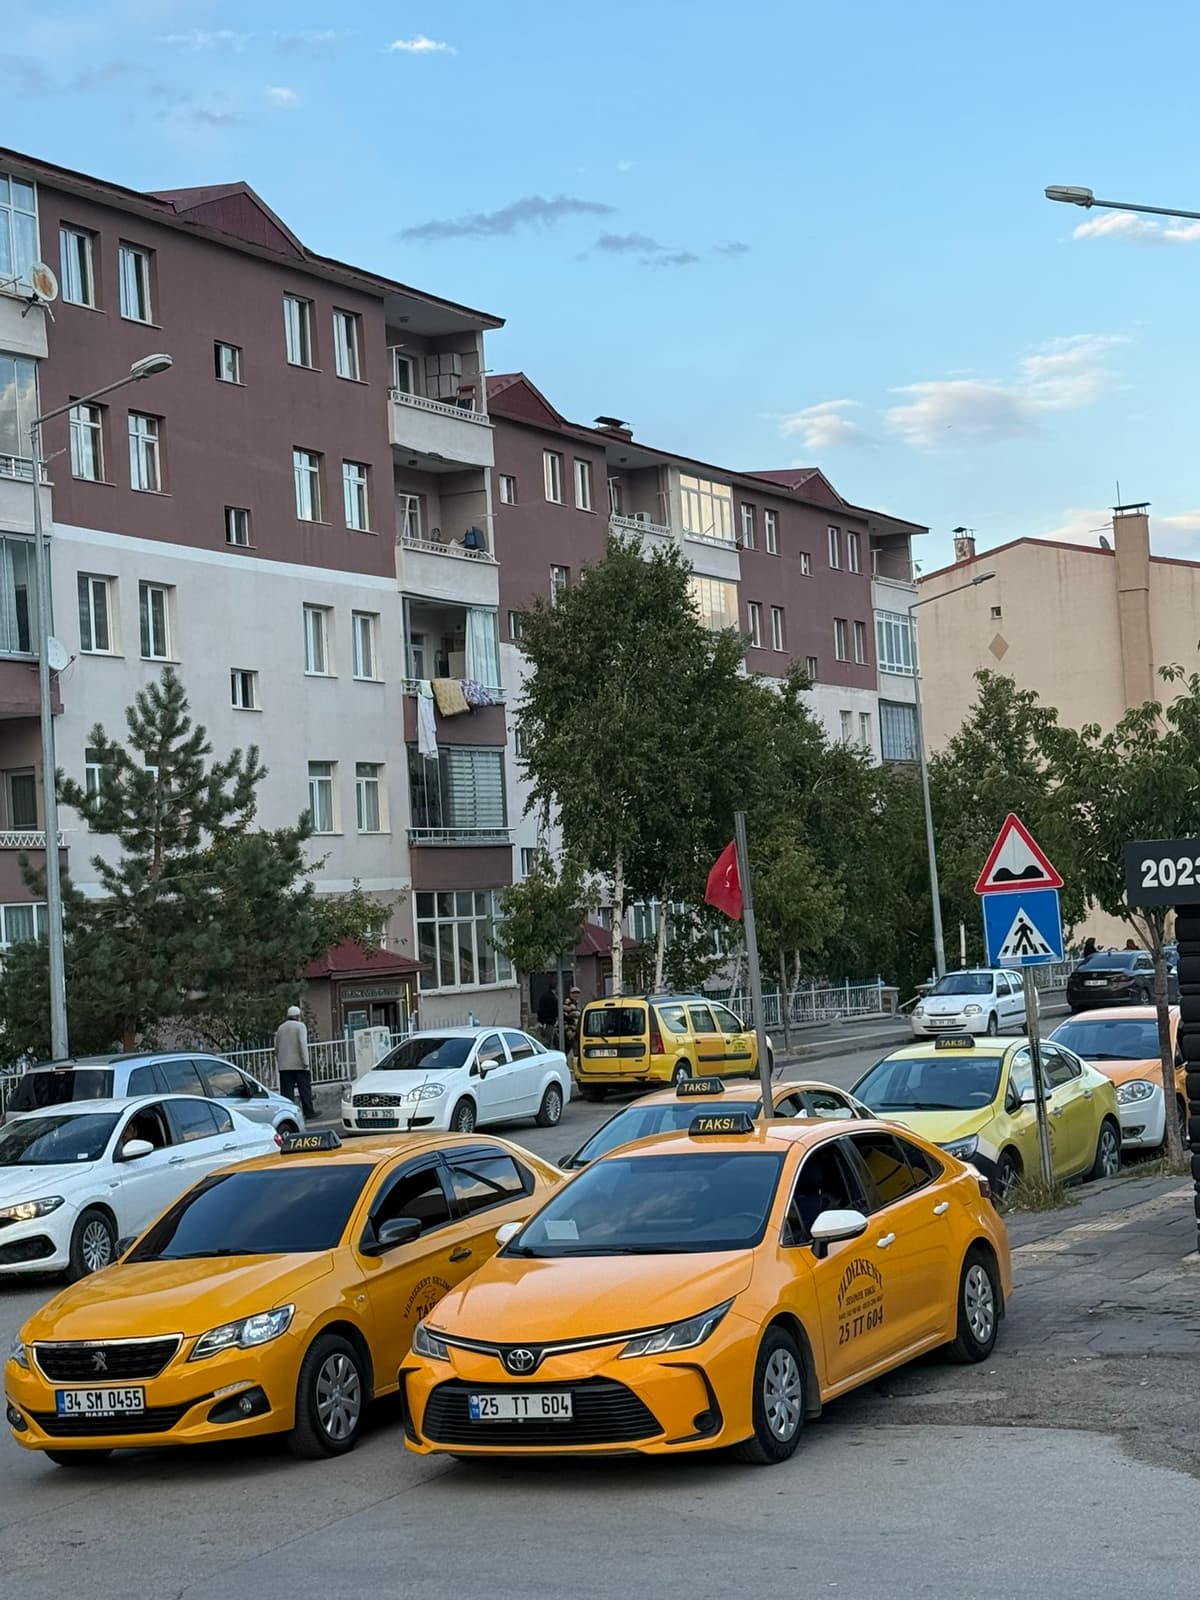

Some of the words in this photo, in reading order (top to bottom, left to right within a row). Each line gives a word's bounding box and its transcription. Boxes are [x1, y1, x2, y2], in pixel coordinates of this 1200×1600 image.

[698, 1118, 735, 1130] TAKSİ
[839, 1322, 850, 1345] 25
[853, 1315, 865, 1337] TT
[866, 1304, 883, 1330] 604
[66, 1393, 81, 1410] 34
[86, 1392, 103, 1409] SM
[108, 1390, 142, 1408] 0455
[480, 1397, 499, 1416] 25
[512, 1396, 529, 1415] TT
[541, 1396, 569, 1414] 604
